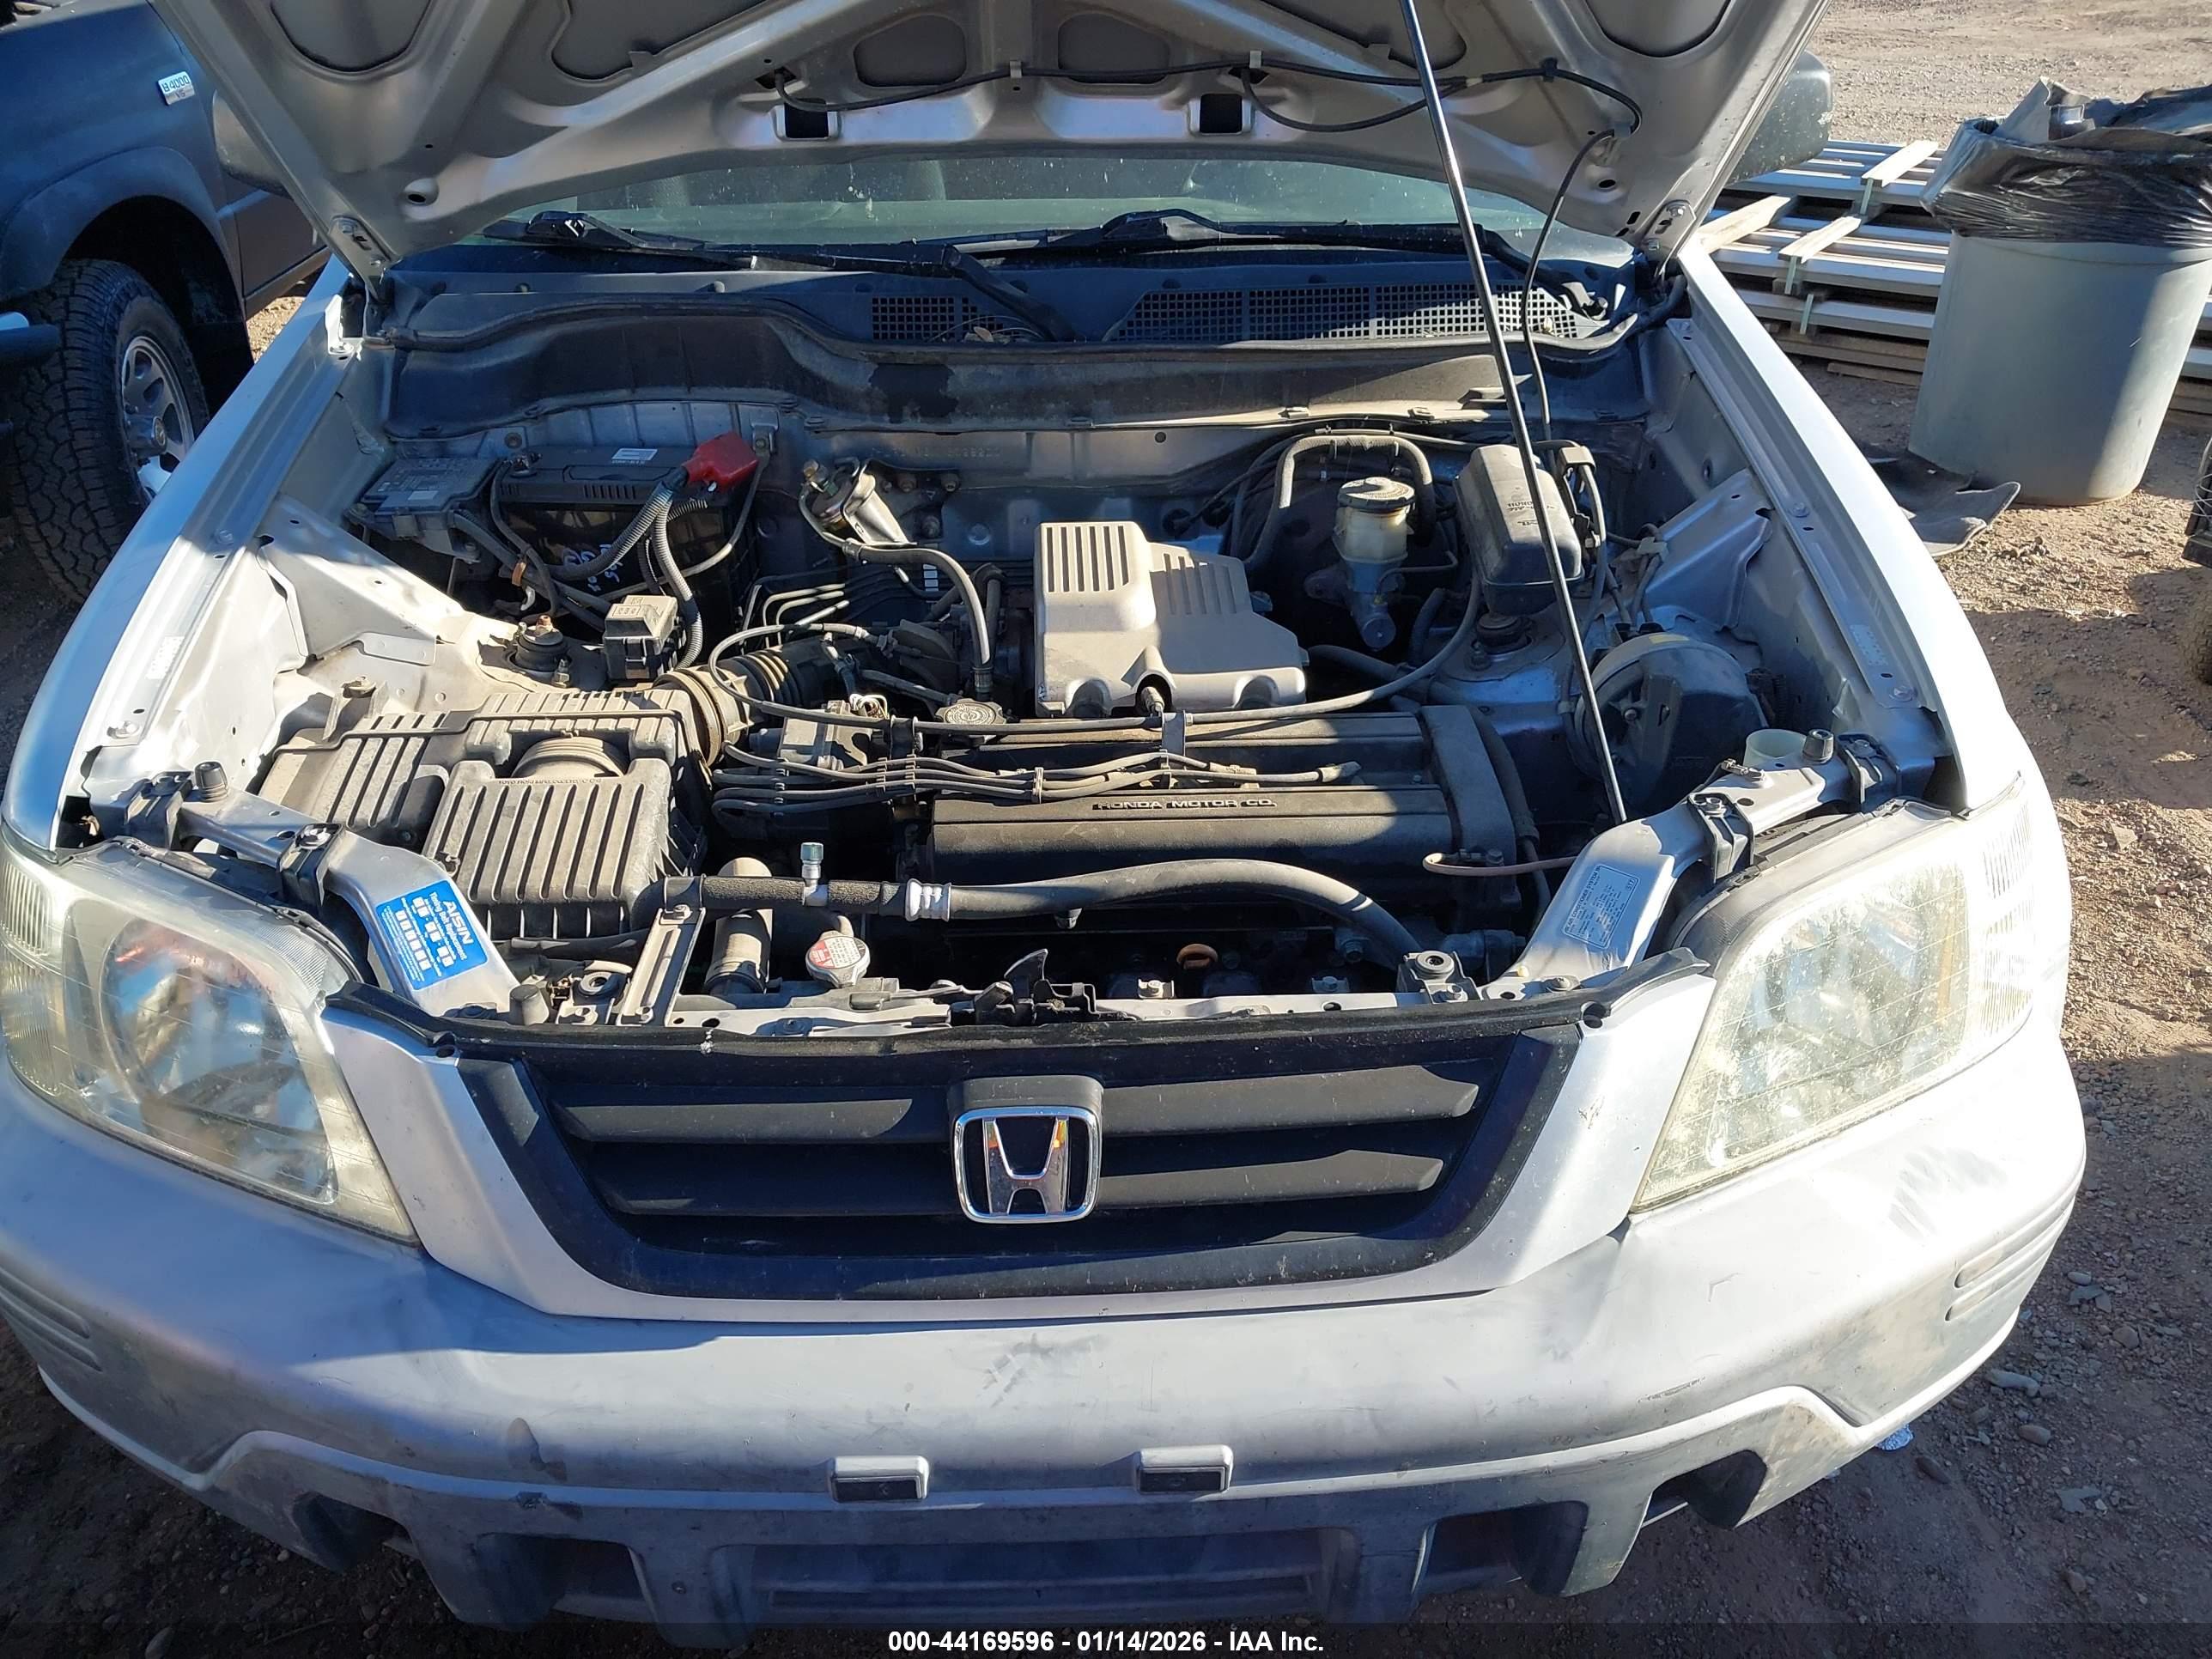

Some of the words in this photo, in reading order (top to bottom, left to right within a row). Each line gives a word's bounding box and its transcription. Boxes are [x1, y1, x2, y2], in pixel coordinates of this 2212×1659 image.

[161, 75, 190, 92] B4000
[1095, 799, 1163, 810] HONDA
[1170, 799, 1237, 809] MOTOR
[429, 891, 442, 913] Timing
[439, 910, 449, 925] Belt
[445, 922, 468, 961] Replacement
[442, 900, 474, 945] AISIN
